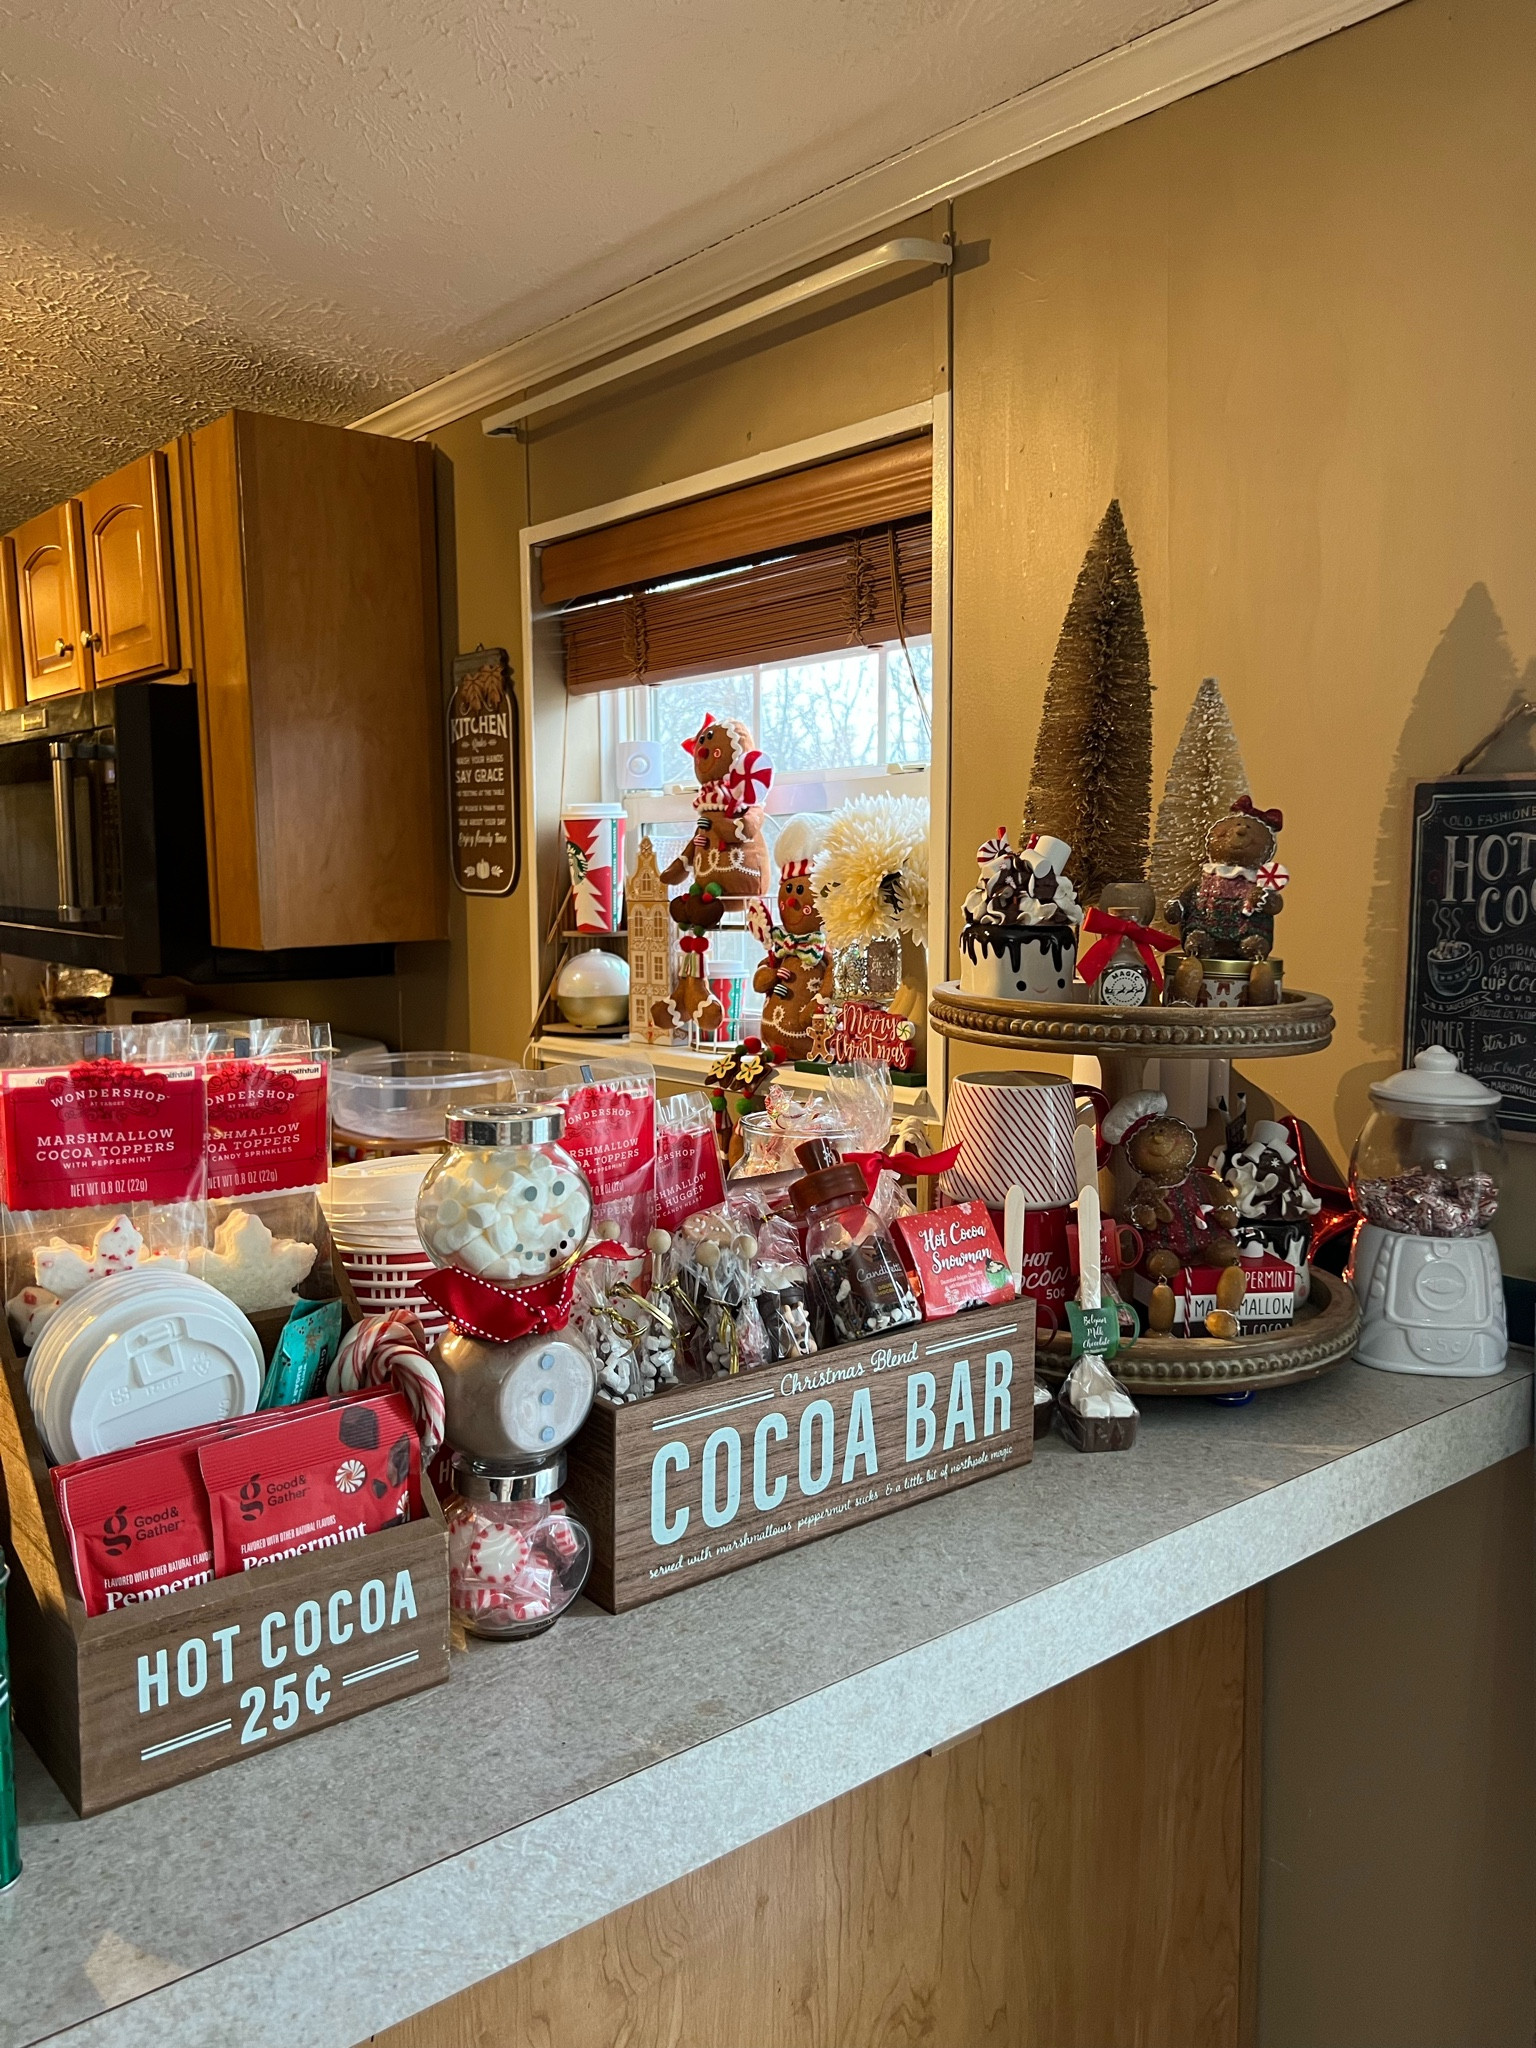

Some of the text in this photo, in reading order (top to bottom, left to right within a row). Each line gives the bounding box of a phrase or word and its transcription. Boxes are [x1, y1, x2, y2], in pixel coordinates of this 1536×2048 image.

[451, 713, 508, 744] KITCHEN
[455, 768, 504, 784] SAY GRACE
[1449, 815, 1472, 827] OLD
[1441, 832, 1536, 903] HOT
[1478, 885, 1536, 934] CO
[1111, 971, 1140, 981] MAGIC
[1481, 976, 1506, 991] CUP
[1495, 992, 1536, 1004] POWD
[837, 1003, 897, 1041] Merry
[1420, 1018, 1465, 1049] SIMMER
[830, 1033, 908, 1069] Christmas
[50, 1088, 166, 1108] WONDERSHOP
[205, 1089, 295, 1107] ONDERSHOP
[565, 1108, 631, 1127] ONDERSHOP
[37, 1128, 174, 1147] MARSHMALLOW
[203, 1122, 300, 1141] RSHMALLOW
[233, 1133, 300, 1150] TOPPERS
[36, 1141, 175, 1161] COCOA TOPPERS
[211, 1146, 293, 1162] CANDY SPRINKLES
[569, 1137, 639, 1158] RSHMALLOW
[594, 1148, 640, 1166] TOPPERS
[657, 1149, 696, 1164] ERSHOP
[62, 1156, 152, 1169] WITH PEPPERMINT
[588, 1161, 626, 1175] PEPPERMINT
[70, 1178, 148, 1198] NET WT 0.8 OZ (22g)
[207, 1168, 278, 1189] NET WT 0.8 OZ (22g)
[665, 1184, 704, 1208] HUGGER
[592, 1205, 633, 1217] OPPERS
[662, 1205, 683, 1217] CANDY
[918, 1221, 986, 1252] Hot Cocoa
[931, 1247, 992, 1274] Snowman
[1022, 1252, 1053, 1267] HOT
[1245, 1270, 1294, 1289] PERMINT
[1046, 1288, 1066, 1300] 50¢
[1195, 1297, 1293, 1317] MAMALLOW
[1253, 1323, 1290, 1336] COCO
[780, 1341, 919, 1396] Christmas Blend
[650, 1349, 1013, 1546] COCOA BAR
[267, 1489, 307, 1507] Gather
[649, 1555, 684, 1579] served
[687, 1546, 713, 1566] with
[716, 1522, 792, 1556] marshmallows
[797, 1500, 851, 1532] peppermint
[885, 1483, 893, 1496] &
[895, 1484, 901, 1492] a
[904, 1474, 924, 1489] little
[926, 1469, 938, 1482] bit
[940, 1464, 948, 1480] of
[950, 1451, 989, 1474] northpole
[991, 1444, 1013, 1462] magic
[136, 1520, 181, 1541] Gather
[241, 1514, 336, 1554] FLAVORED WITH OTHER NATURAL FLAVORS
[242, 1521, 367, 1571] Peppermint
[104, 1574, 133, 1589] FLAVORED
[133, 1570, 149, 1583] WITH
[149, 1564, 167, 1579] OTHER
[168, 1557, 192, 1573] NATURAL
[105, 1568, 215, 1612] Pepperm
[137, 1569, 418, 1714] HOT COCOA
[240, 1664, 331, 1745] 25¢
